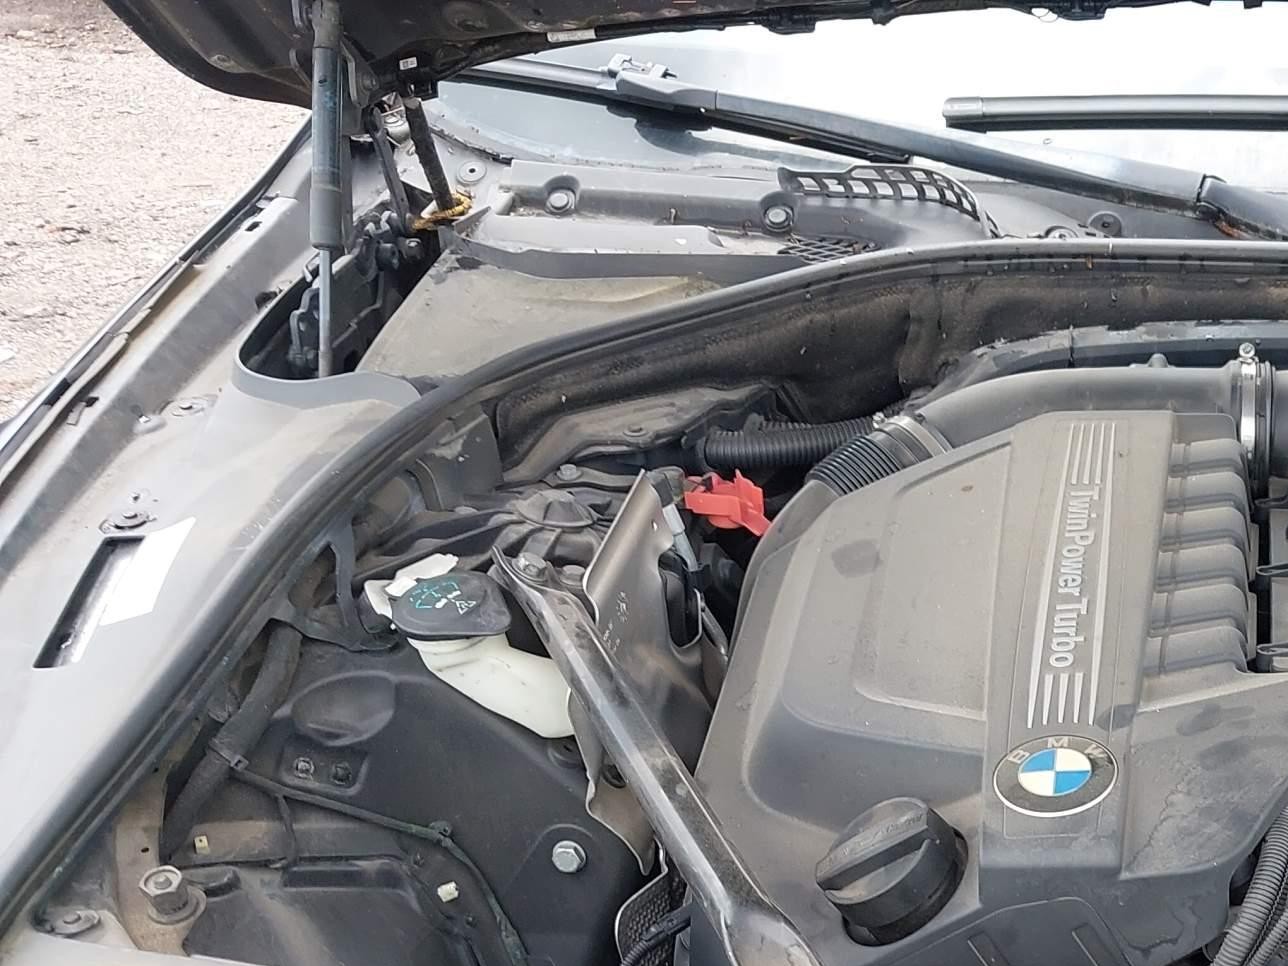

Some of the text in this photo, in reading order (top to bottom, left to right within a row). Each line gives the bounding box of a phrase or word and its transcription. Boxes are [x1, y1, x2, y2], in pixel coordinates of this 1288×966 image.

[1049, 485, 1100, 668] TwinPower Turbo
[1007, 737, 1113, 768] BMW
